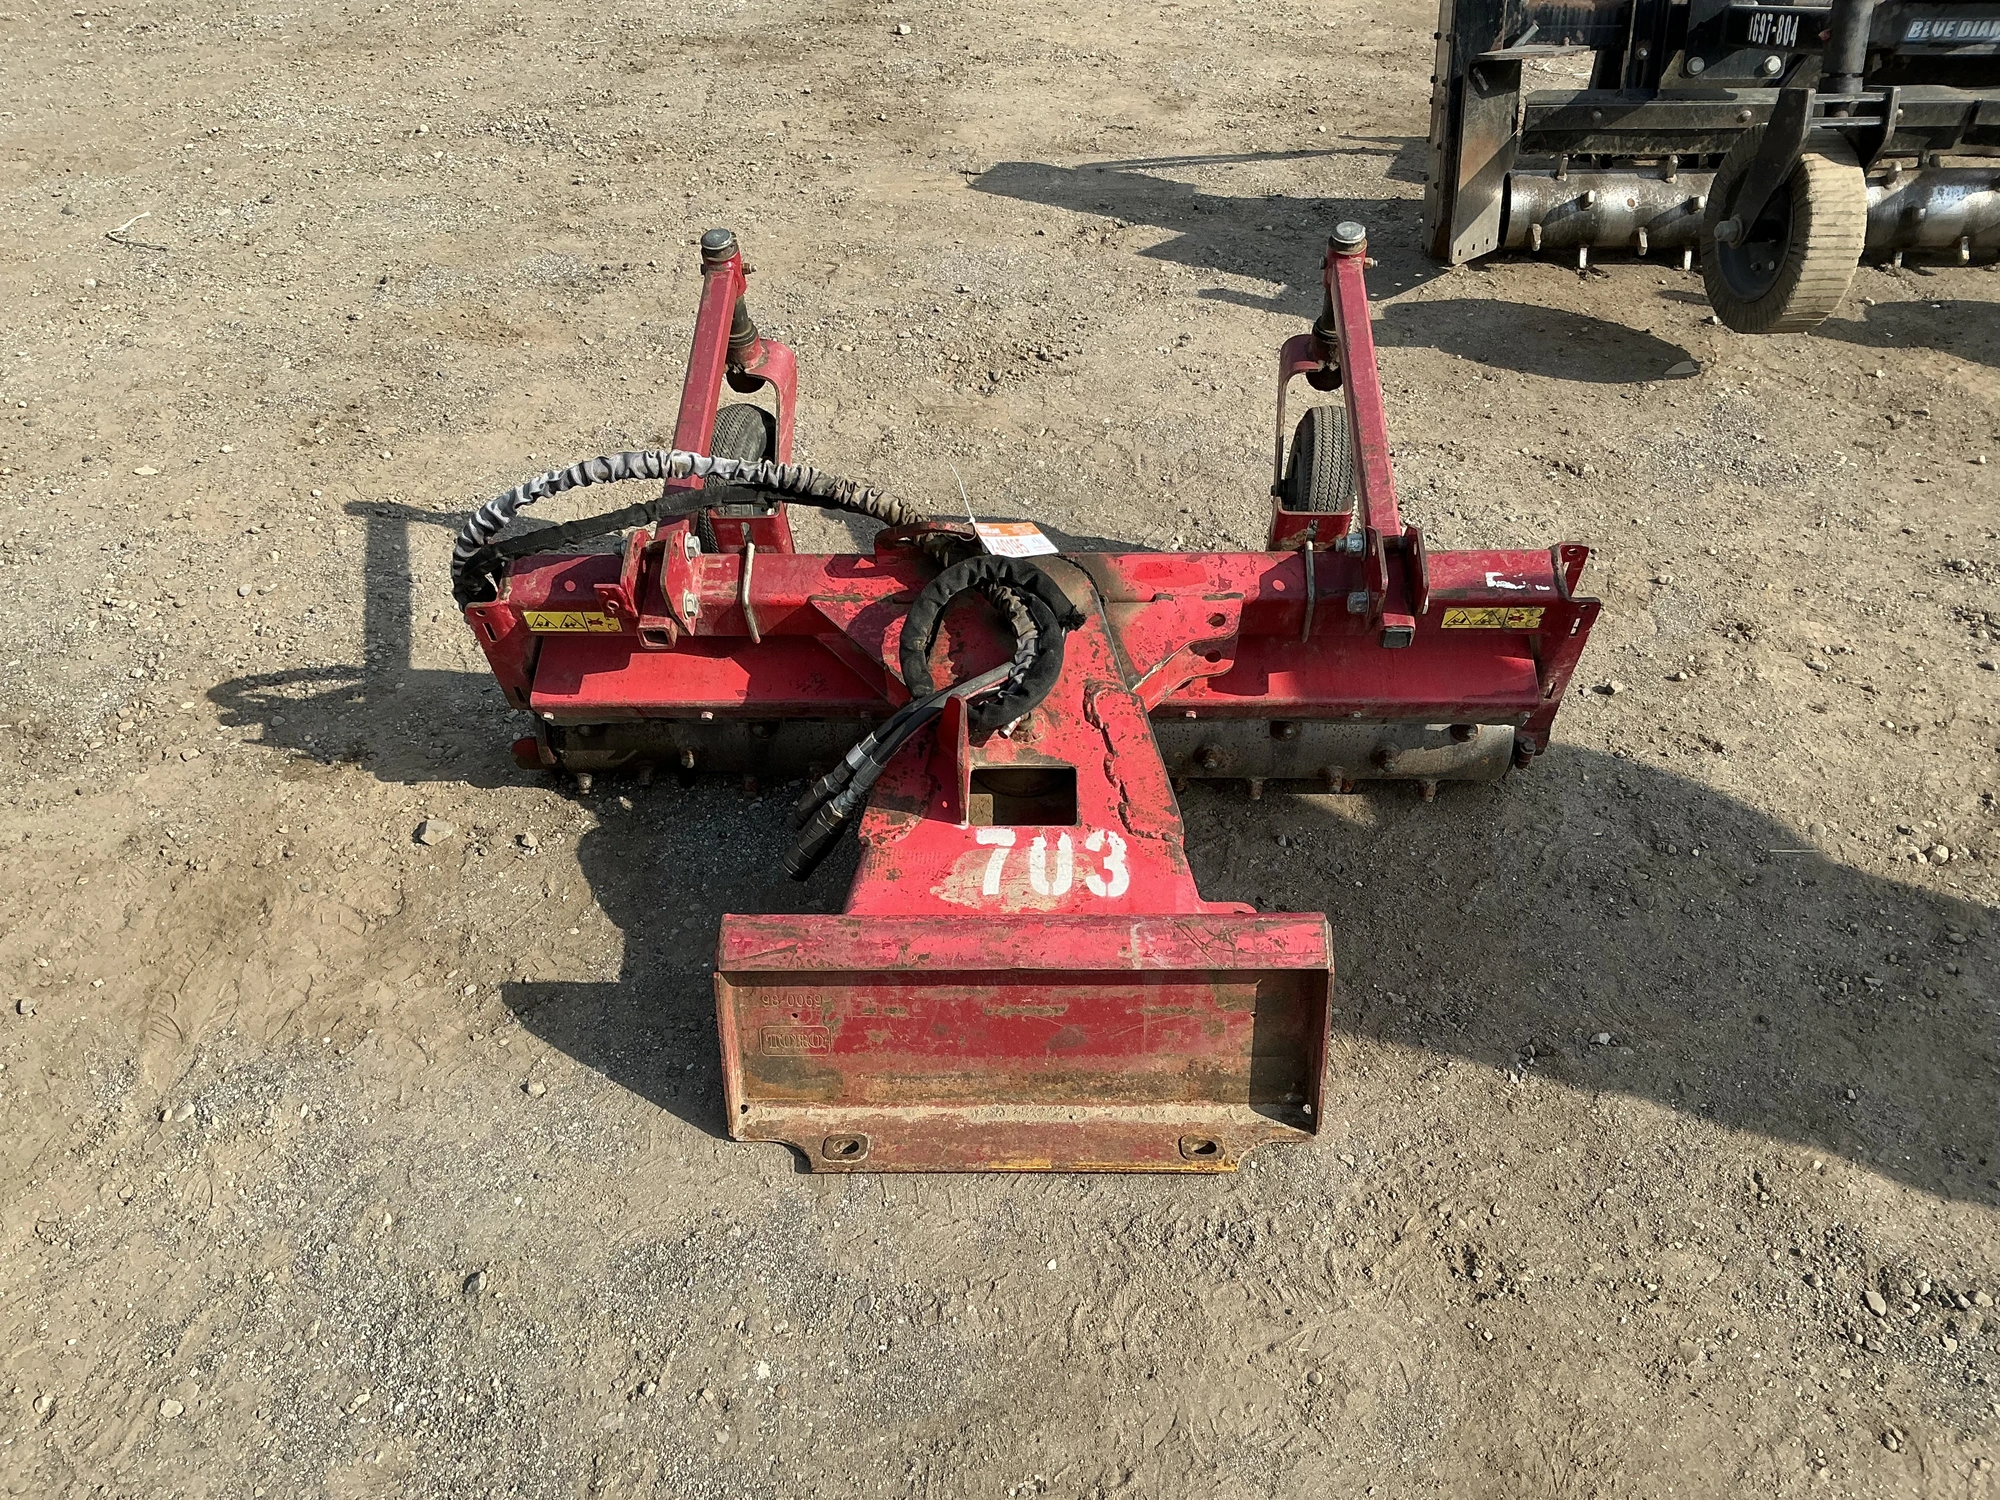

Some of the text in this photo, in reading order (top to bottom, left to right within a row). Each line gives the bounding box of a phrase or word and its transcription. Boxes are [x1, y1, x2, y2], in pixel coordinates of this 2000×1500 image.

[1748, 12, 1799, 48] 1697-804
[1907, 20, 1957, 38] BLUE
[975, 828, 1130, 897] 703
[766, 1032, 826, 1049] TORO
